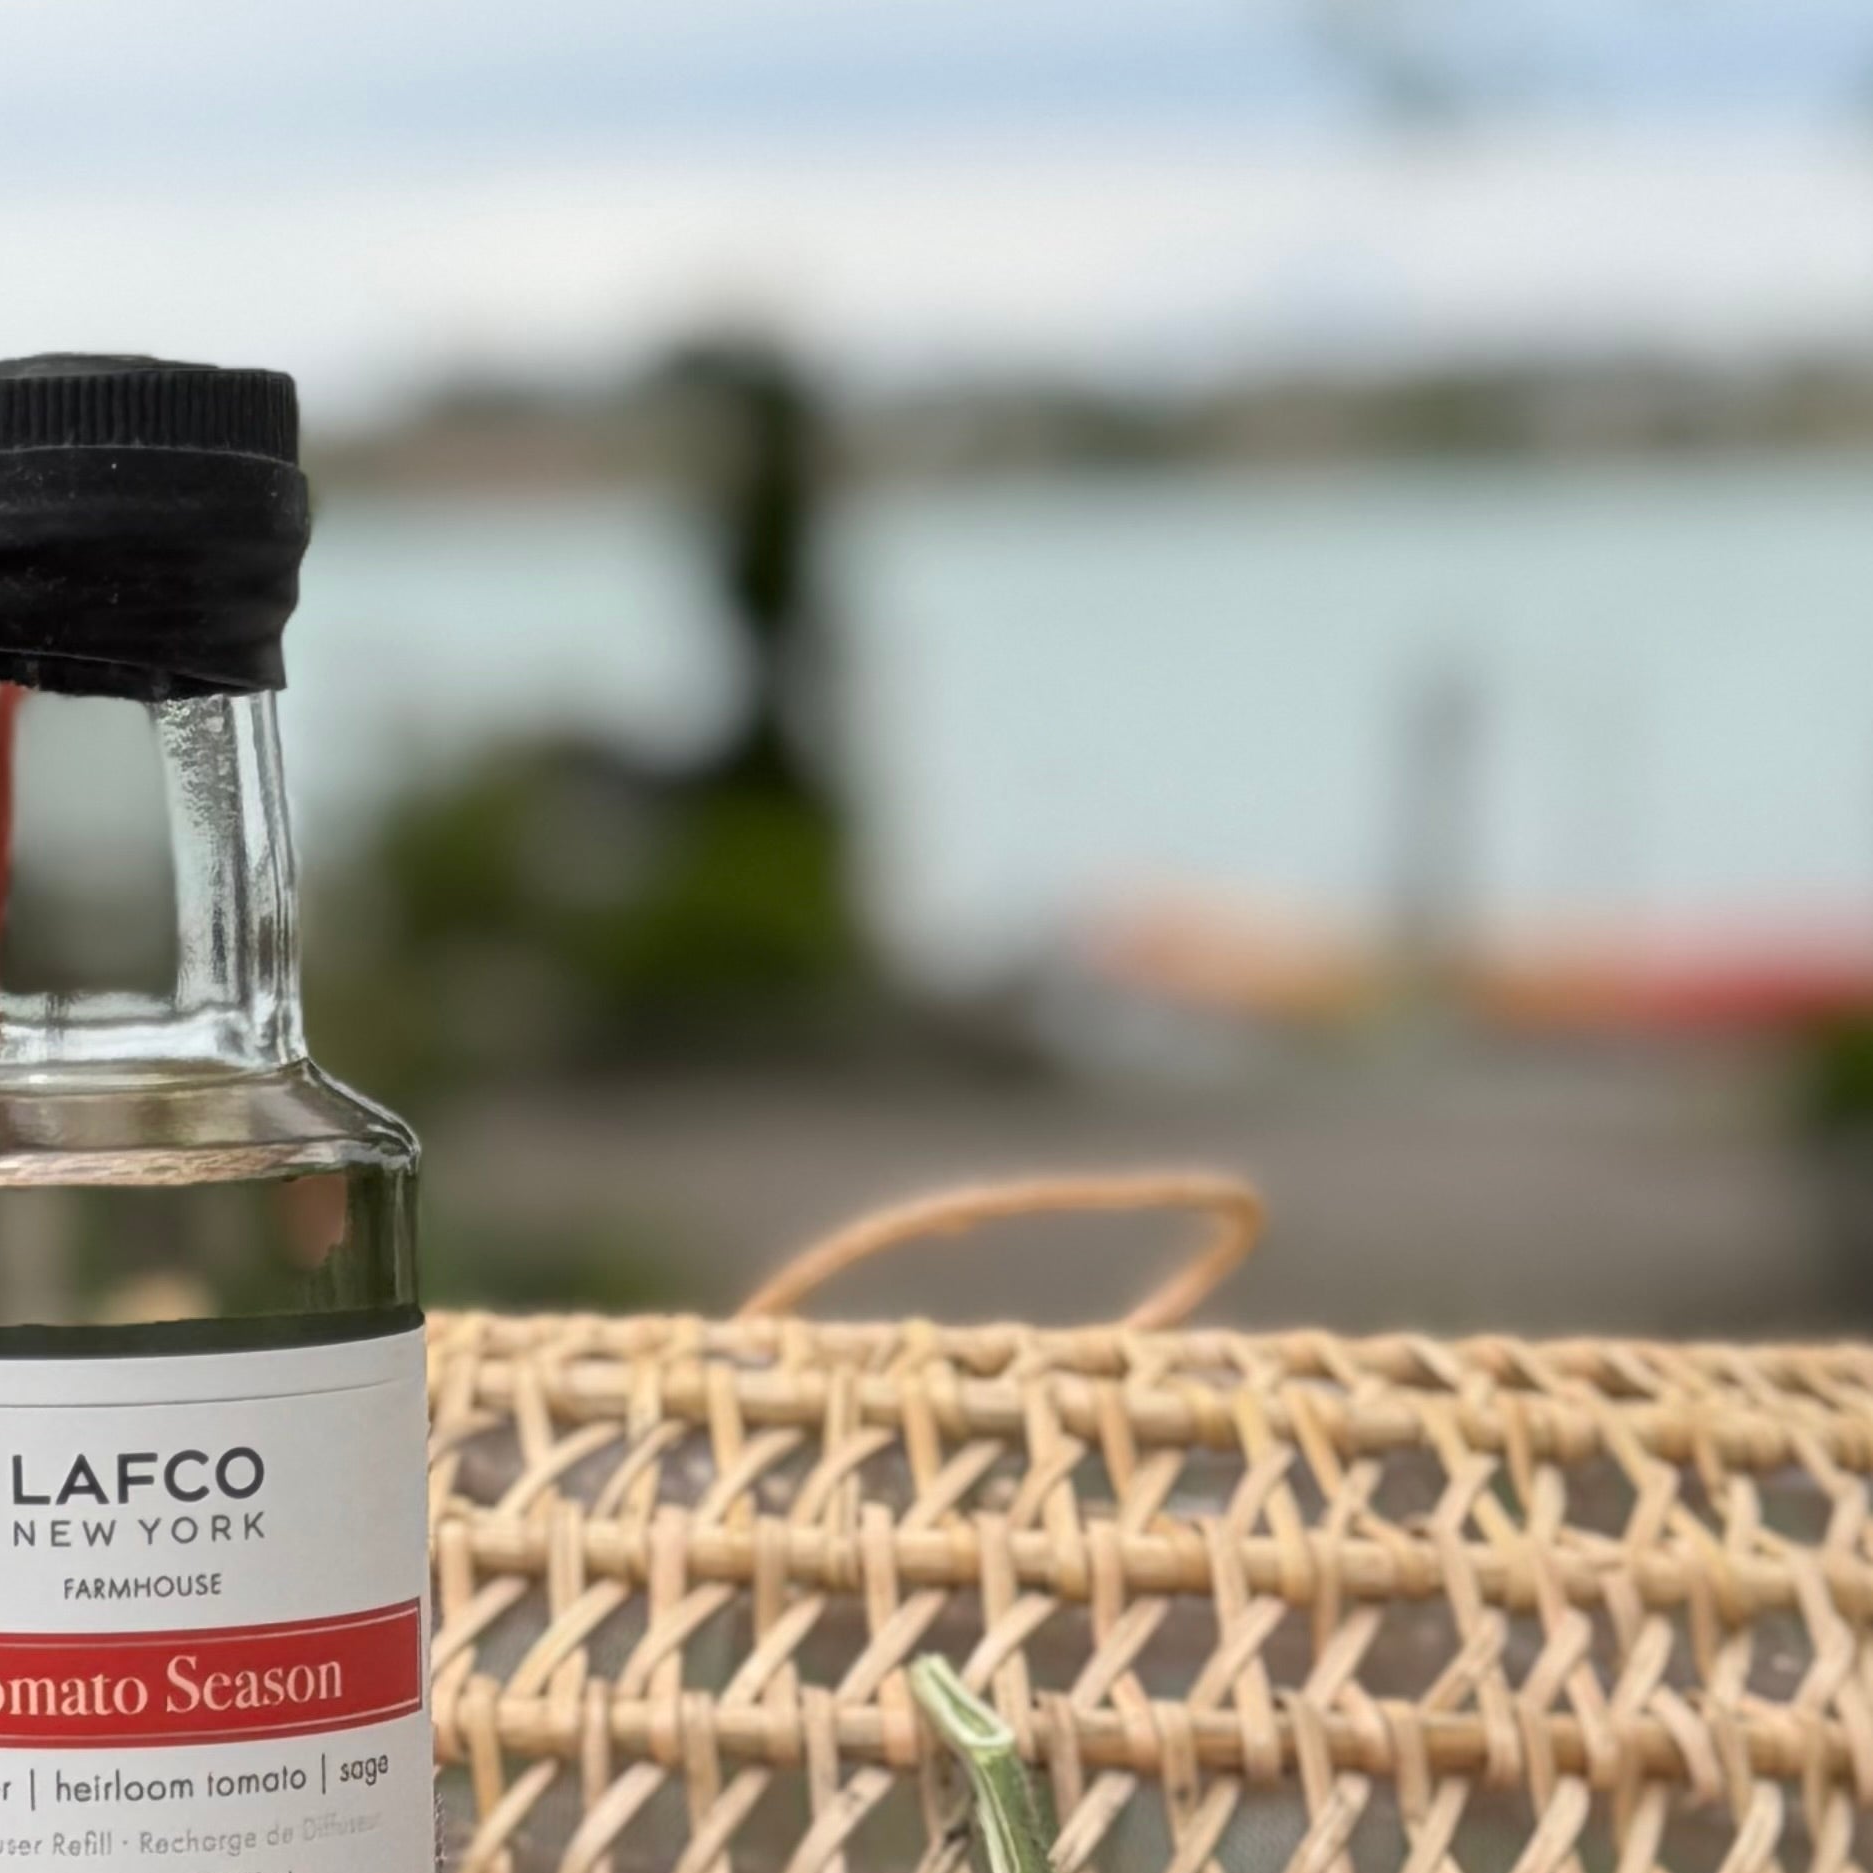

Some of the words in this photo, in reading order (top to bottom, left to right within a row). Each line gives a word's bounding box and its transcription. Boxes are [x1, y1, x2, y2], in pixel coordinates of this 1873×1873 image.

[12, 1446, 265, 1506] LAFCO
[13, 1519, 116, 1547] NEW
[138, 1510, 266, 1545] YORK
[63, 1573, 223, 1600] FARMHOUSE
[166, 1654, 343, 1713] Season
[55, 1769, 194, 1803] heirloom
[207, 1766, 307, 1797] tomato
[339, 1753, 390, 1785] sage
[52, 1832, 113, 1857] Refill
[140, 1824, 257, 1858] Recharge
